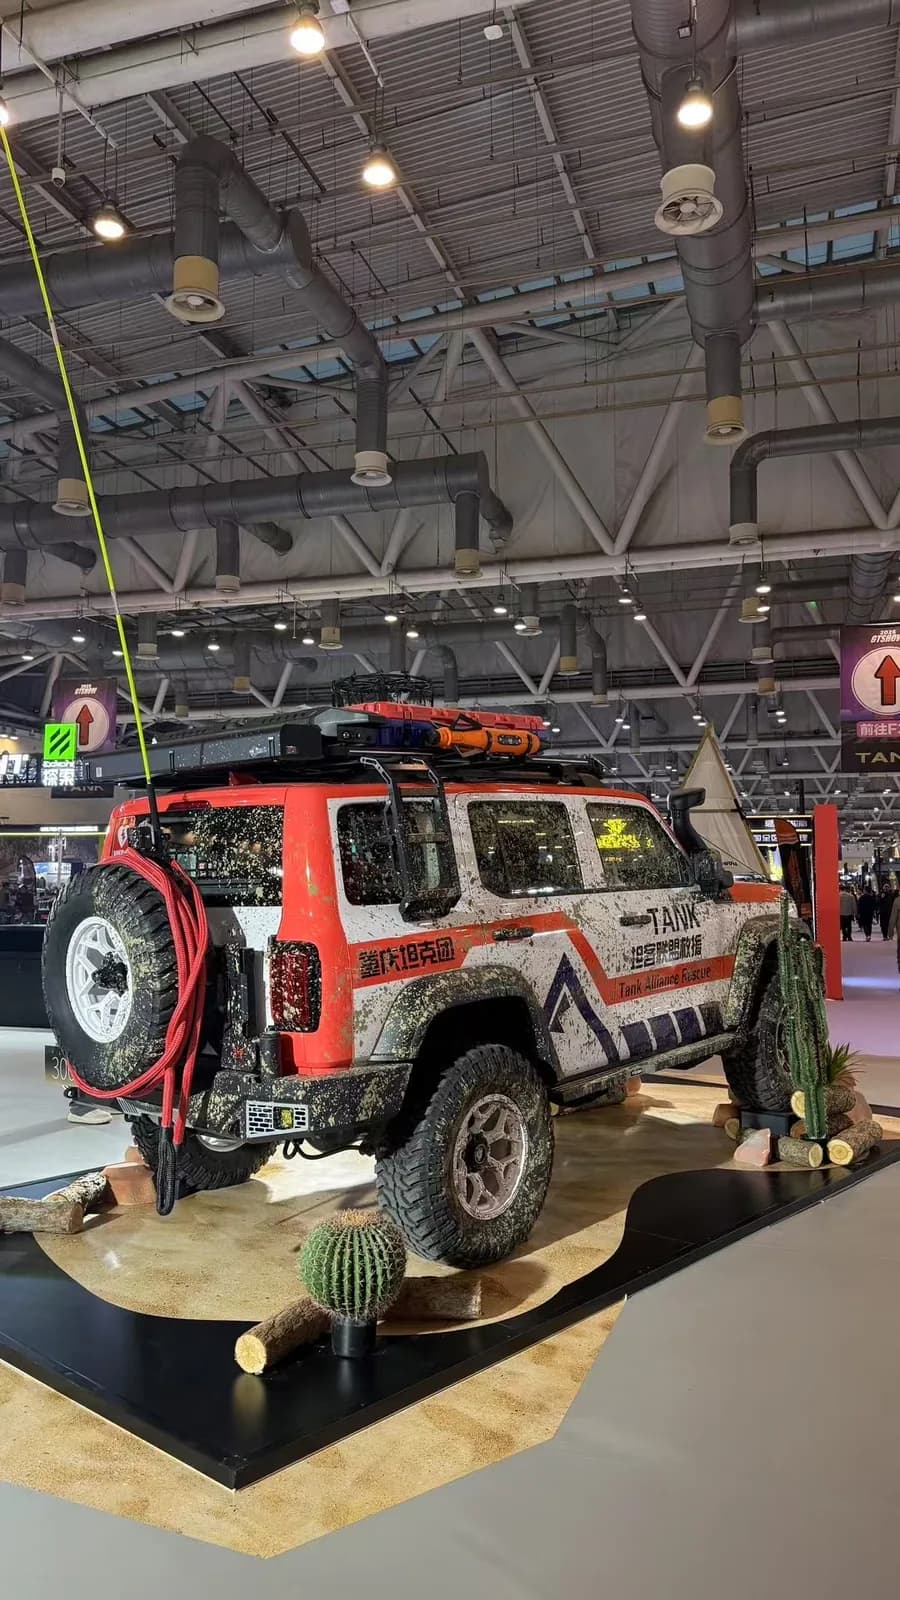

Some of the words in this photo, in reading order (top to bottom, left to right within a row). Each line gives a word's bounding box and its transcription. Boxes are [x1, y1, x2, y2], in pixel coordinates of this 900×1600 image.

[646, 902, 702, 935] TANK
[358, 936, 455, 979] 重庆坦克团
[619, 979, 642, 998] Tank
[645, 972, 680, 990] Alliance
[681, 966, 712, 983] Rescue
